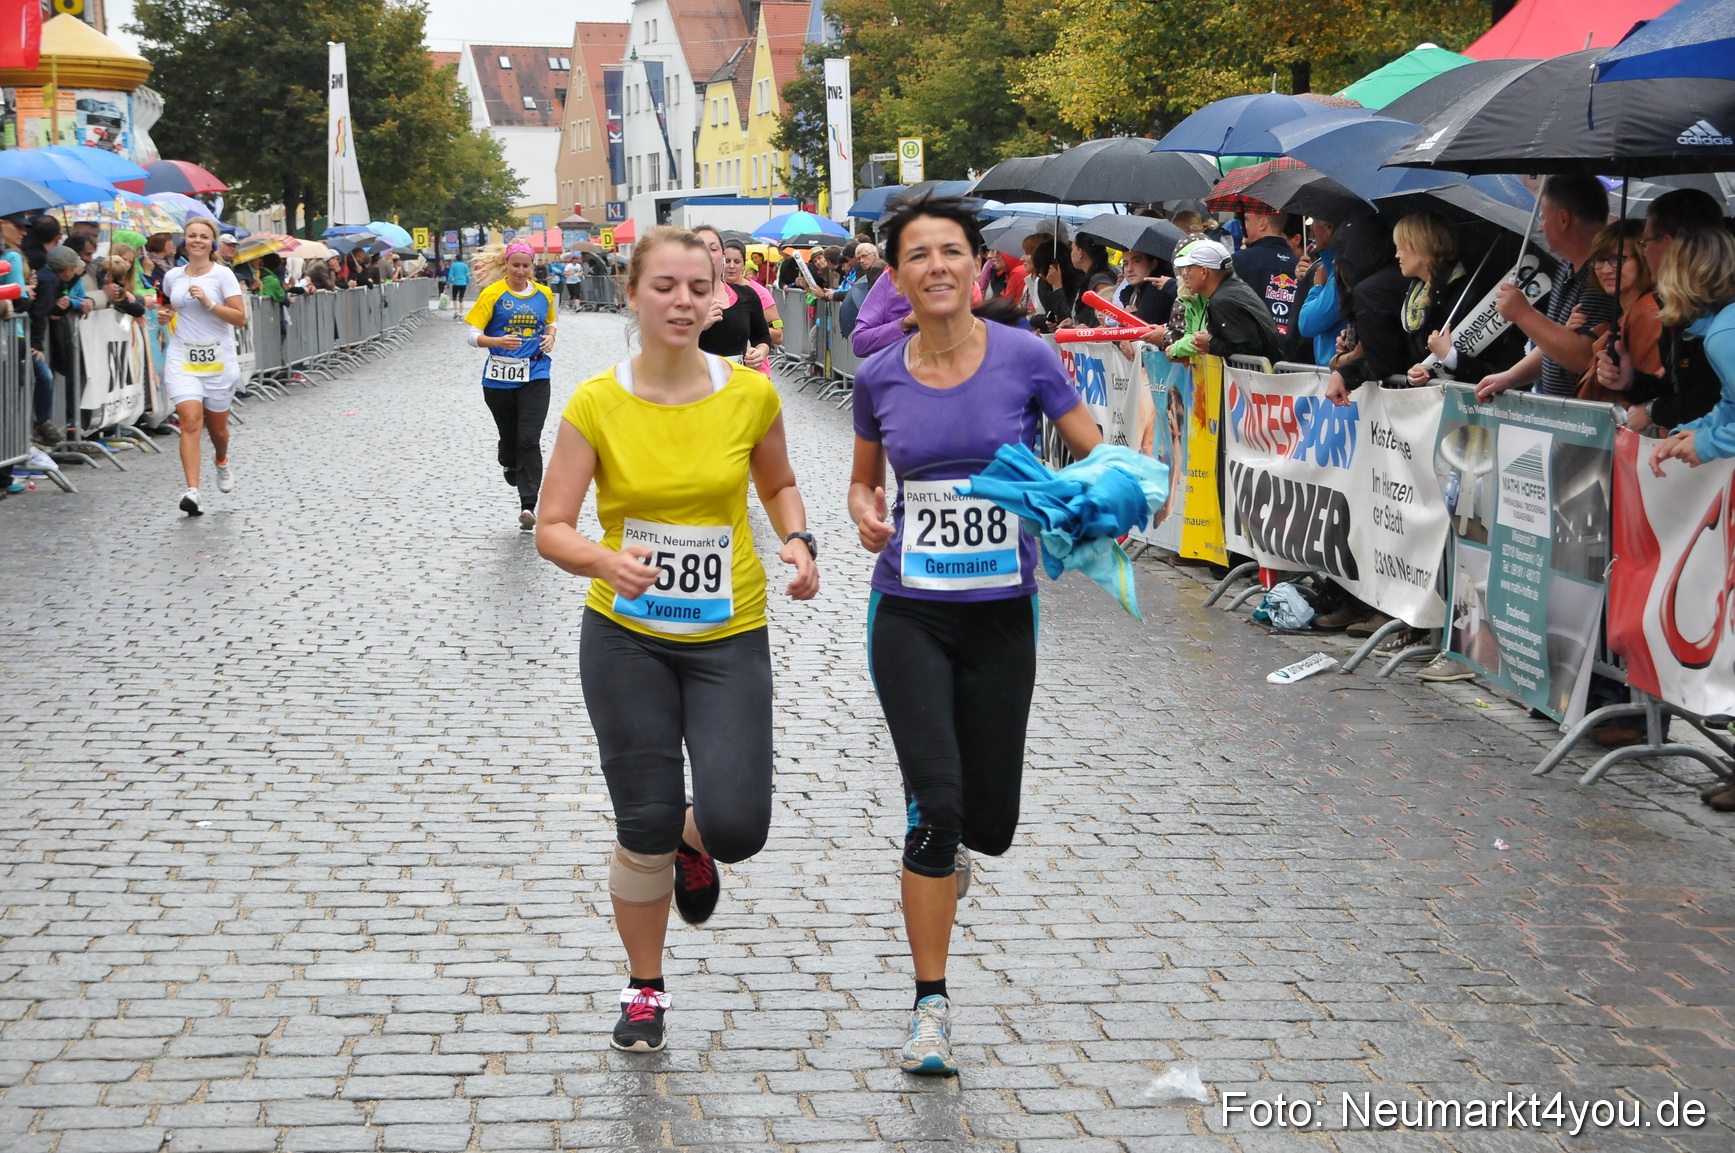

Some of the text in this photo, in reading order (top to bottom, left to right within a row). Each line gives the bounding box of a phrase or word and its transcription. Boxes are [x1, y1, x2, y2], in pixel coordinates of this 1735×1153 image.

[1676, 134, 1734, 146] adidas
[417, 235, 424, 245] D
[604, 234, 612, 244] D
[190, 349, 215, 362] 633
[491, 364, 525, 380] 5104
[1382, 472, 1414, 504] Herzen
[1520, 482, 1546, 501] HOFFER
[907, 492, 941, 502] PARTL
[916, 506, 1007, 547] 2588
[1384, 505, 1404, 535] Stadt
[625, 528, 715, 547] PARTL Neumarkt
[636, 551, 722, 593] 589
[925, 558, 998, 574] Germaine
[646, 600, 701, 619] Yvonne
